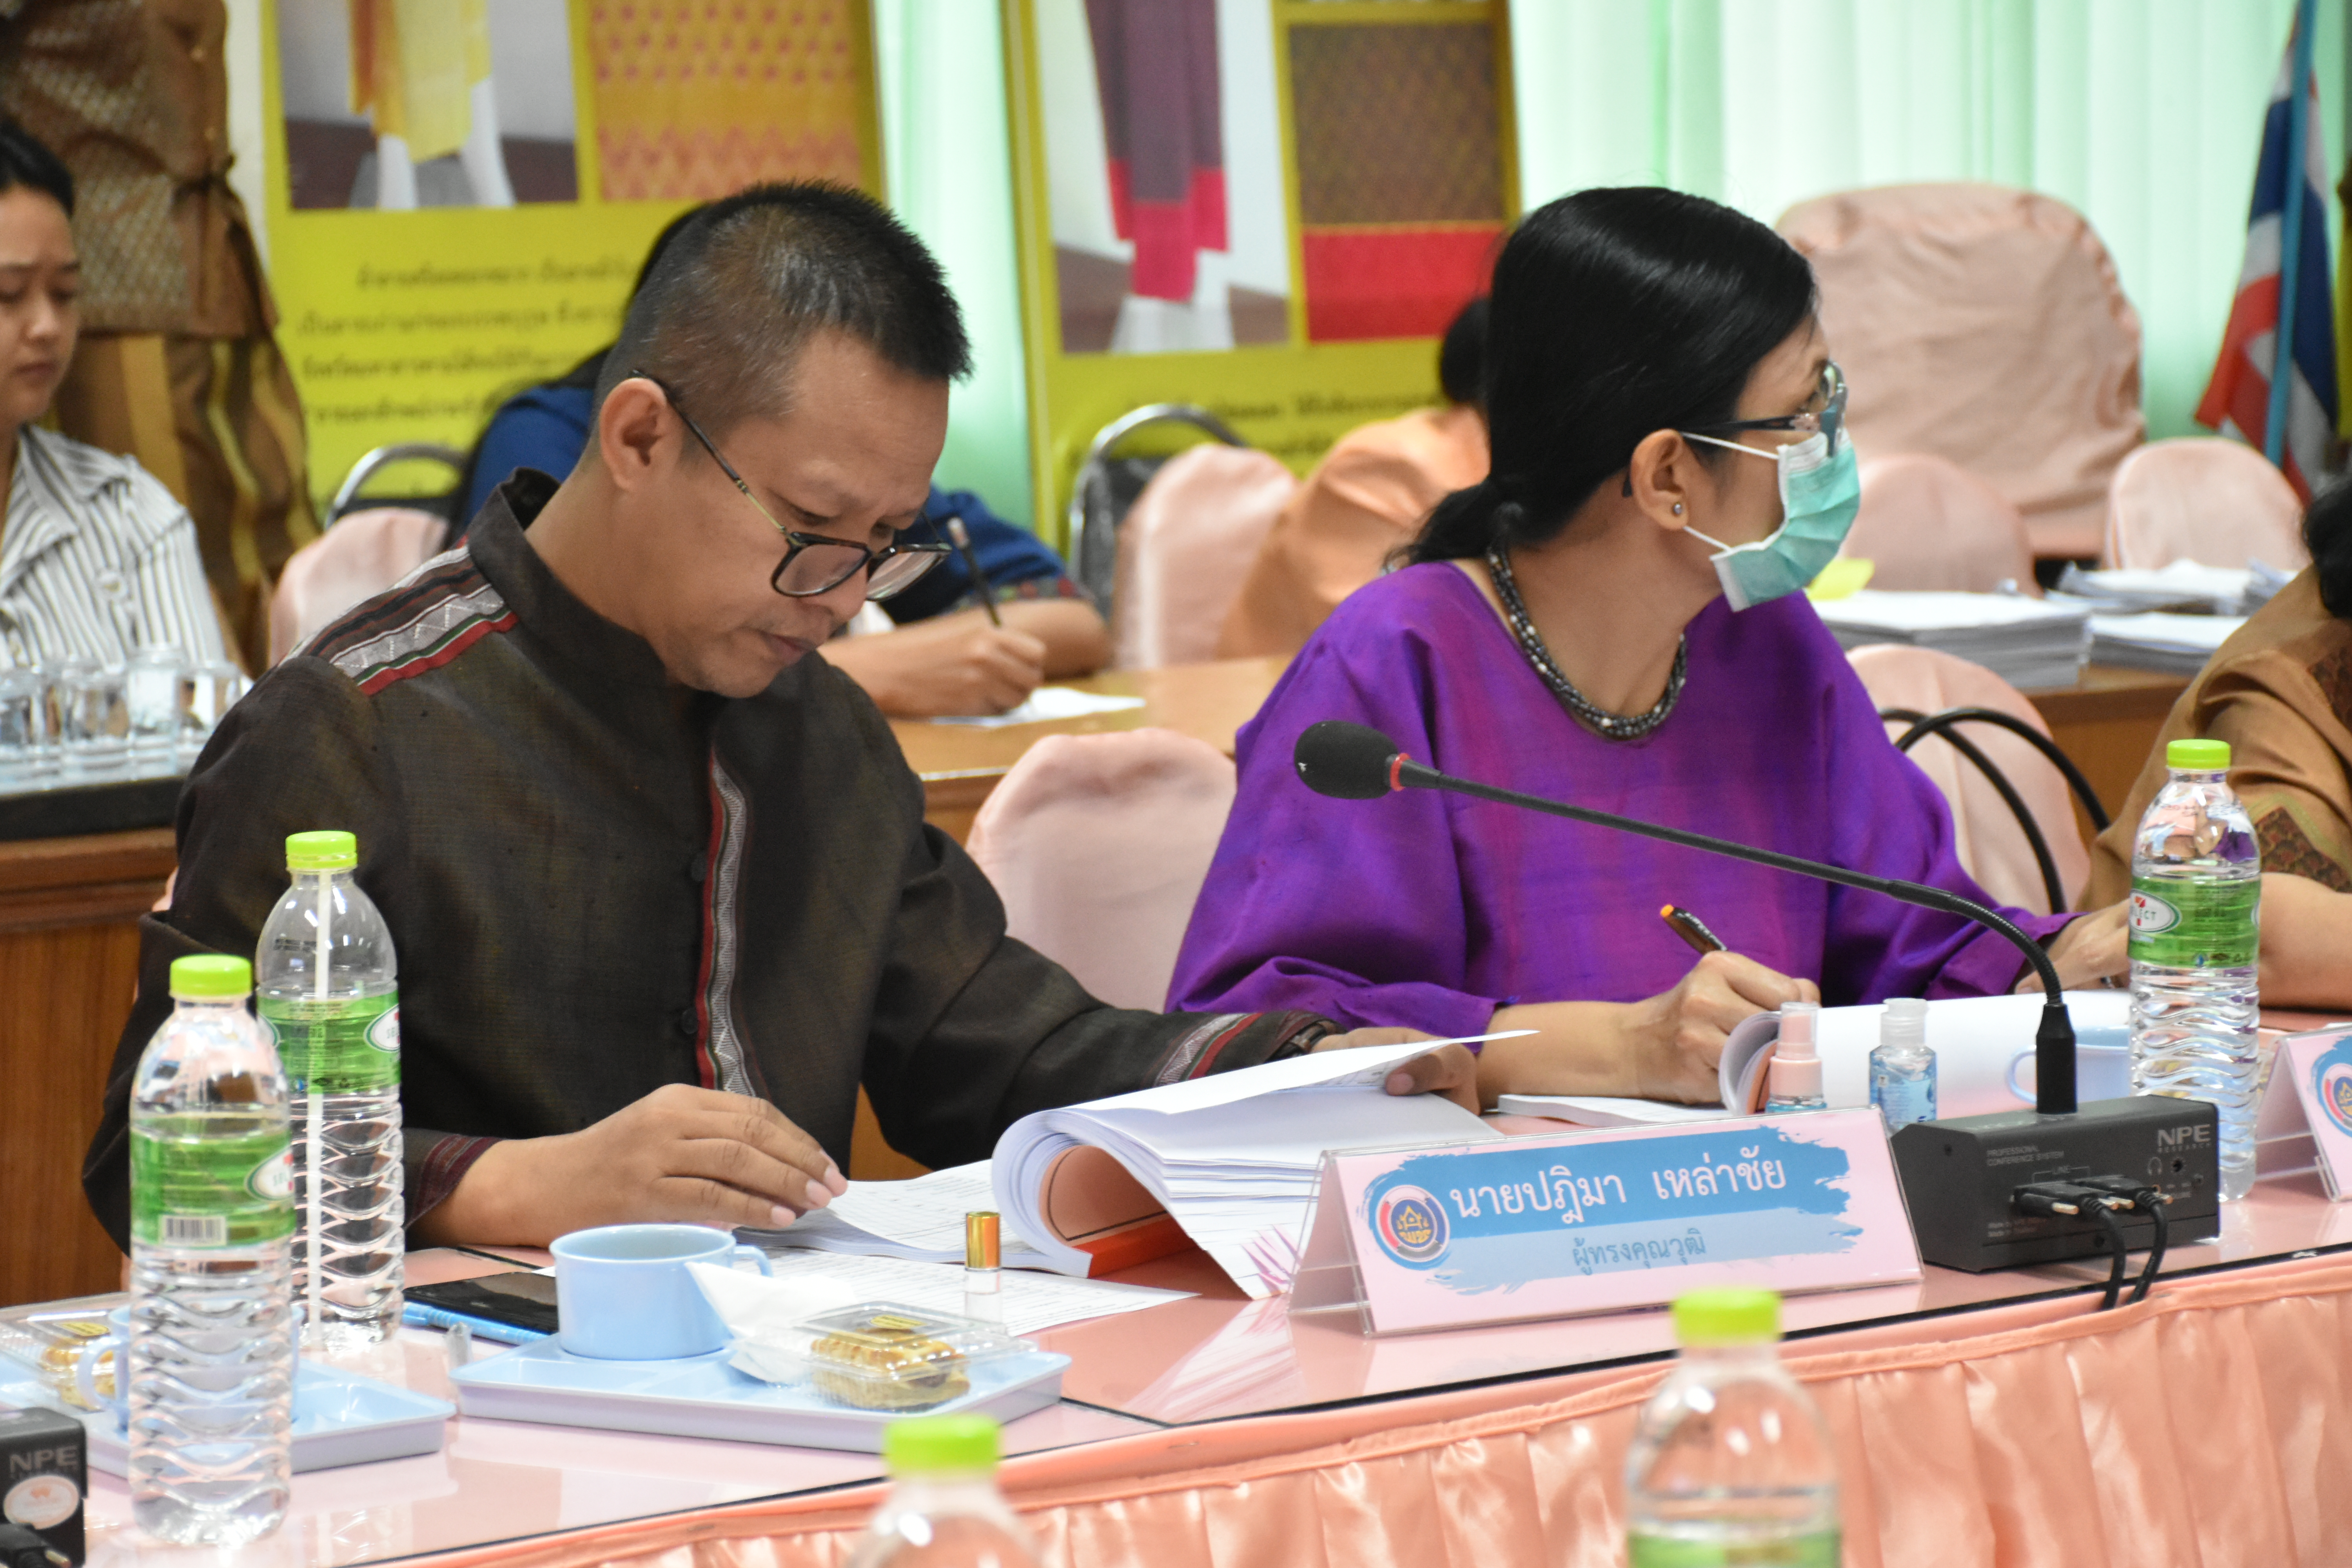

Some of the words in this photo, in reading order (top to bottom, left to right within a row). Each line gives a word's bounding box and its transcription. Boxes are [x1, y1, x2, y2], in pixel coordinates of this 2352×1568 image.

[2157, 1123, 2211, 1147] NPE
[1652, 1145, 1786, 1200] เหล่าชัย
[1572, 1227, 1707, 1276] ผู้ทรงคุณวุฒิ
[10, 1445, 78, 1473] NPE
